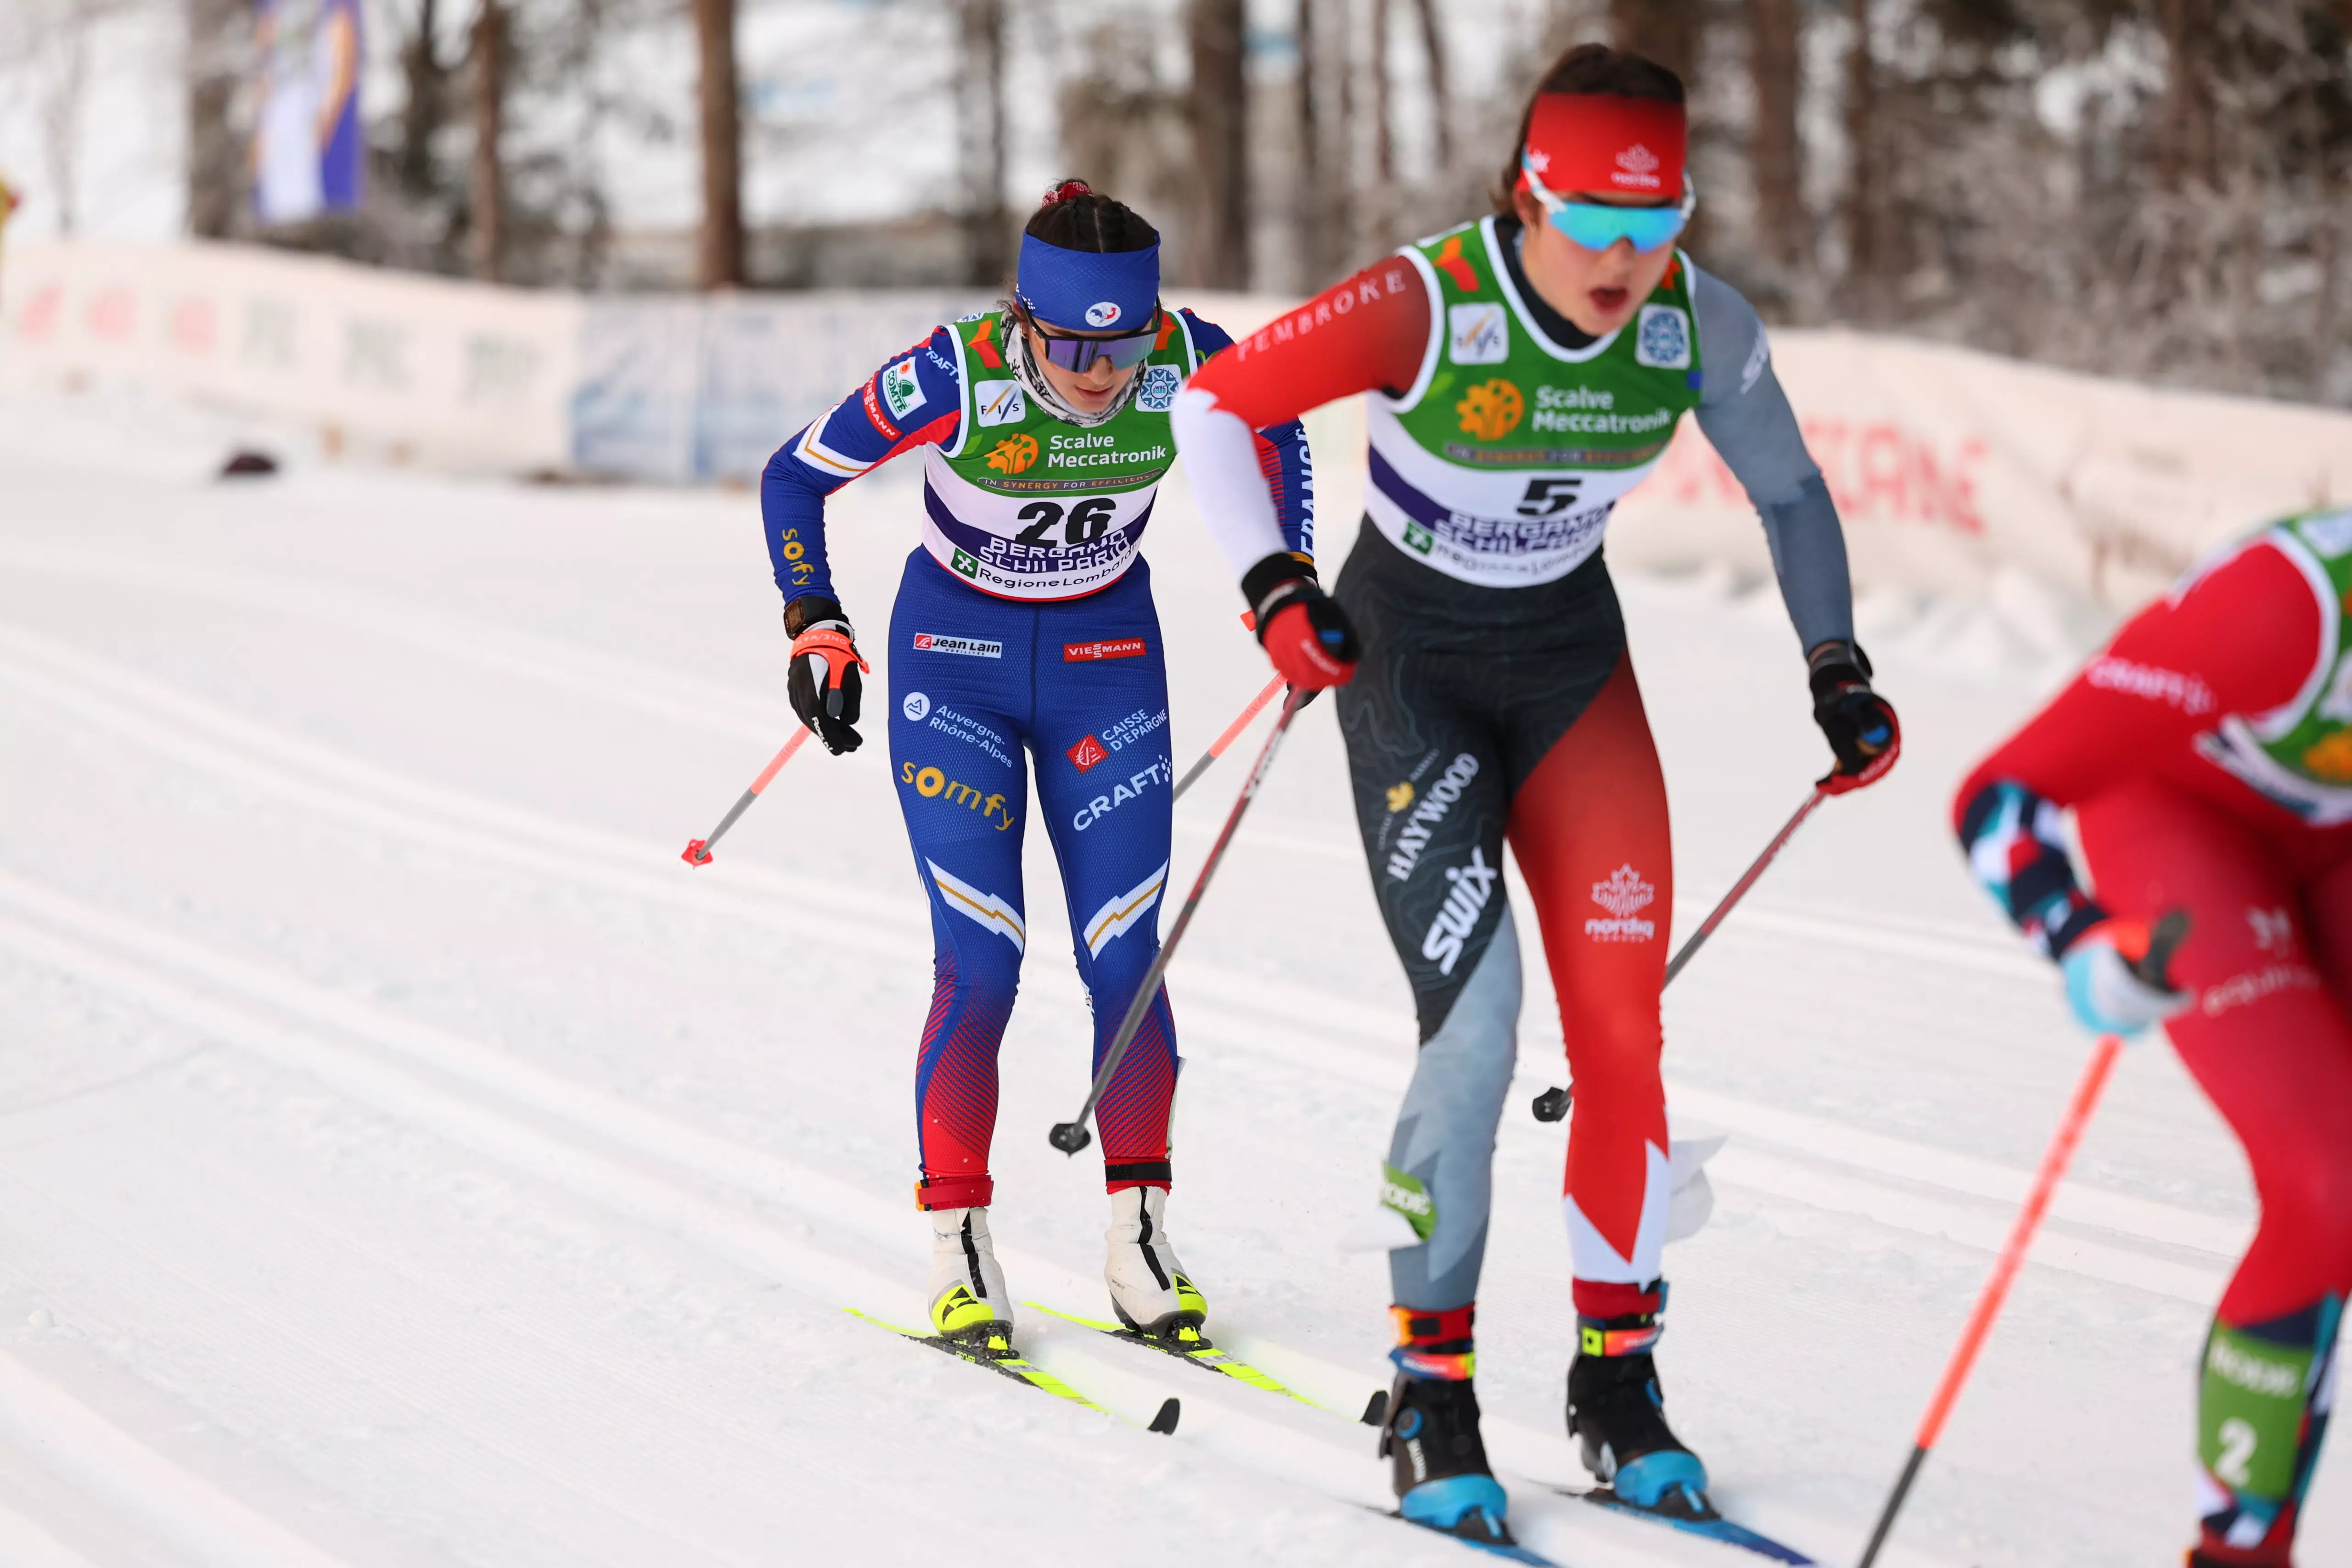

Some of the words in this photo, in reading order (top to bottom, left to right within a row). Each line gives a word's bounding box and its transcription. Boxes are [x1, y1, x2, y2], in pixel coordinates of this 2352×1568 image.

[1237, 269, 1406, 362] PEMBROKE
[1535, 385, 1614, 410] Scalve
[1050, 433, 1115, 450] Scalve
[1532, 408, 1673, 434] Meccatronik
[1048, 445, 1166, 468] Meccatronik
[1516, 477, 1583, 517] 5
[1014, 498, 1117, 548] 26
[932, 638, 967, 650] Jean
[969, 642, 1000, 654] Lain
[930, 717, 1012, 768] Rhône-Alpes
[935, 705, 1005, 746] Auvergne-
[1102, 709, 1149, 741] CAISSE
[901, 762, 1015, 831] somfy
[1073, 763, 1162, 831] CRAFT
[1387, 752, 1479, 881] HAYWOOD
[2213, 1416, 2258, 1487] 2
